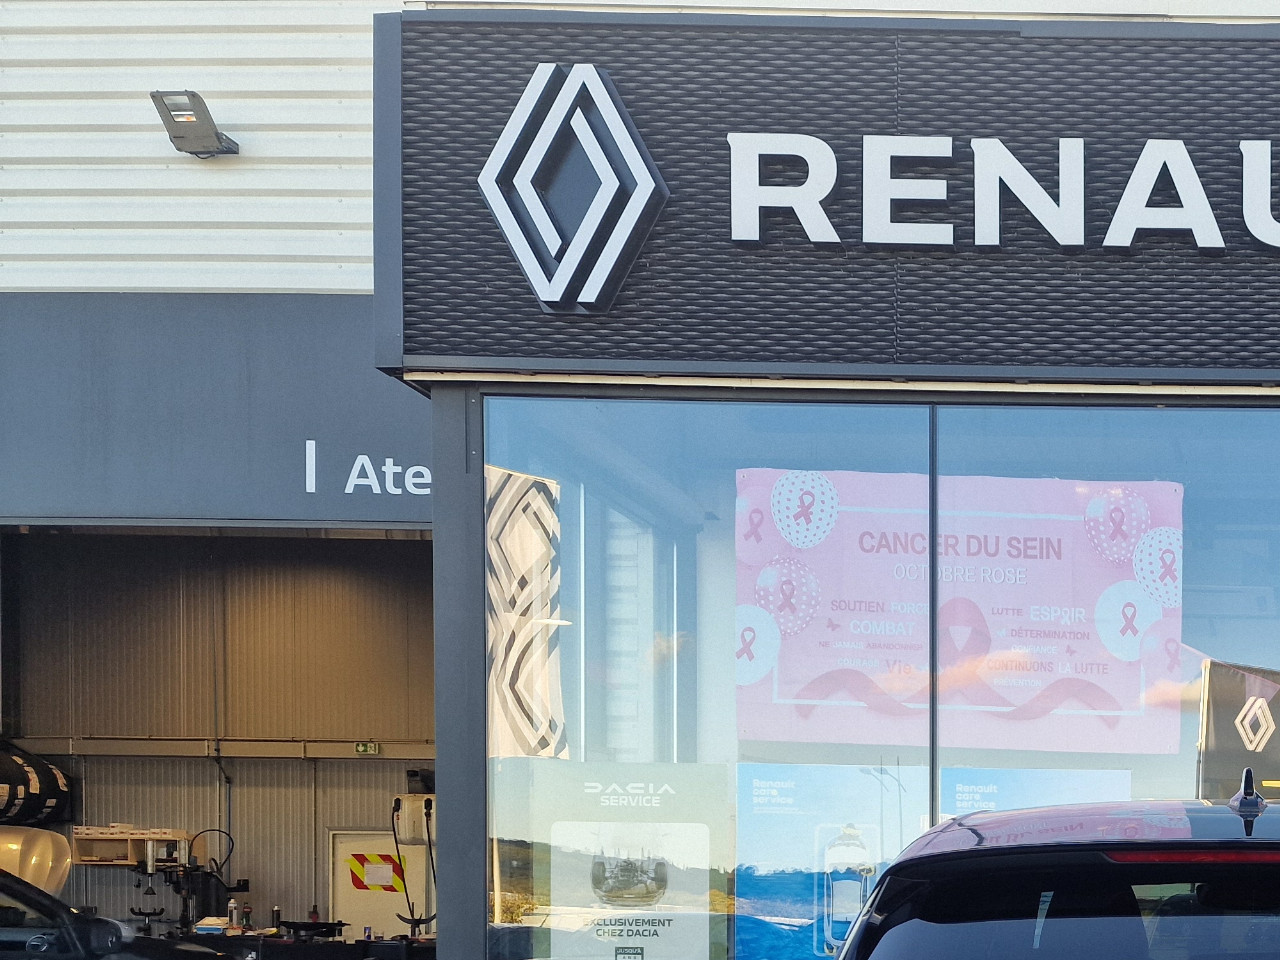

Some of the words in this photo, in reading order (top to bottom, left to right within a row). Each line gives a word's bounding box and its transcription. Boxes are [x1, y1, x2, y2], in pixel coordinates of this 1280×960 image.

[966, 534, 1000, 558] DU
[1006, 536, 1062, 560] SEIN
[980, 566, 1028, 585] ROSE
[831, 600, 885, 613] SOUTIEN
[991, 607, 1024, 617] LUTTE
[849, 620, 916, 636] COMBAT
[1010, 626, 1090, 640] DÉTERMINATION
[1011, 645, 1058, 654] CONFIANCE
[885, 659, 912, 675] Vie
[987, 660, 1054, 672] CONTINUONS
[1058, 662, 1072, 674] LA
[1074, 663, 1109, 674] LUTTE
[584, 782, 676, 794] DACIA
[955, 784, 998, 793] Renault
[600, 796, 661, 807] SERVICE
[956, 800, 996, 809] service
[583, 918, 674, 928] EXCLUSIVEMENT
[595, 928, 624, 937] CHEZ
[626, 928, 660, 938] DACIA
